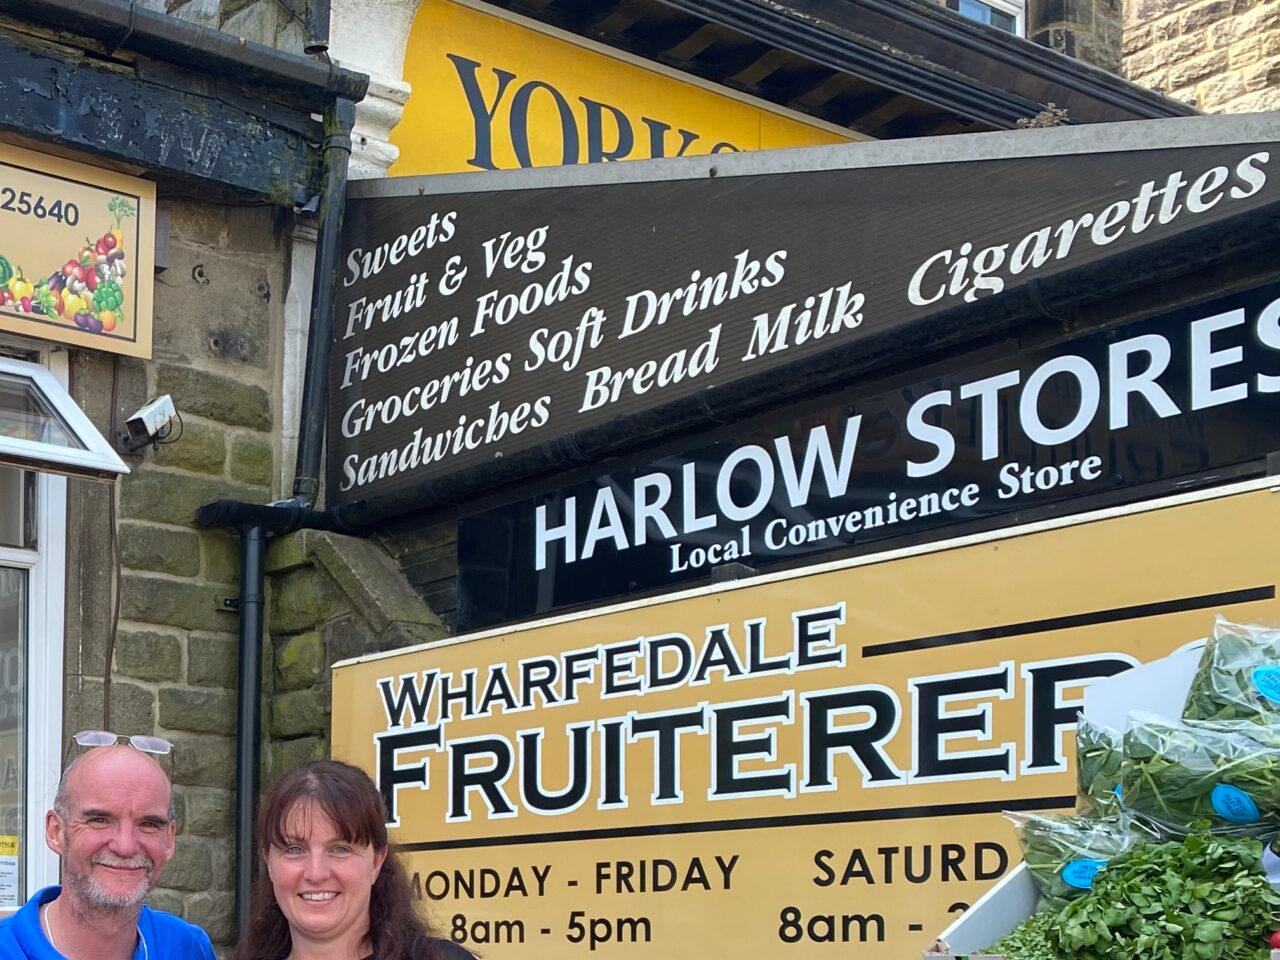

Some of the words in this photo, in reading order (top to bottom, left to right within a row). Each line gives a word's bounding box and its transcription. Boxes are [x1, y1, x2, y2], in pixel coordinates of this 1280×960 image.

[343, 272, 429, 340] Fruit
[439, 255, 467, 296] &
[482, 225, 549, 278] Veg
[344, 211, 457, 287] Sweets
[339, 395, 551, 491] Sandwiches
[578, 323, 722, 413] Bread
[741, 281, 865, 362] Milk
[907, 151, 1270, 306] Cigarettes
[340, 316, 459, 390] Frozen
[470, 255, 592, 337] Foods
[341, 352, 512, 438] Groceries
[524, 306, 606, 372] Soft
[617, 249, 787, 339] Drinks
[535, 414, 863, 571] HARLOW
[670, 524, 751, 573] Local
[764, 482, 979, 551] Convenience
[997, 455, 1102, 499] Store
[377, 602, 846, 727] WHARFEDALE
[411, 865, 552, 901] ONDAY
[596, 855, 740, 894] FRIDAY
[813, 842, 1008, 887] SATURD
[451, 913, 525, 944] 8am
[566, 911, 652, 950] 5pm
[779, 906, 885, 943] 8am
